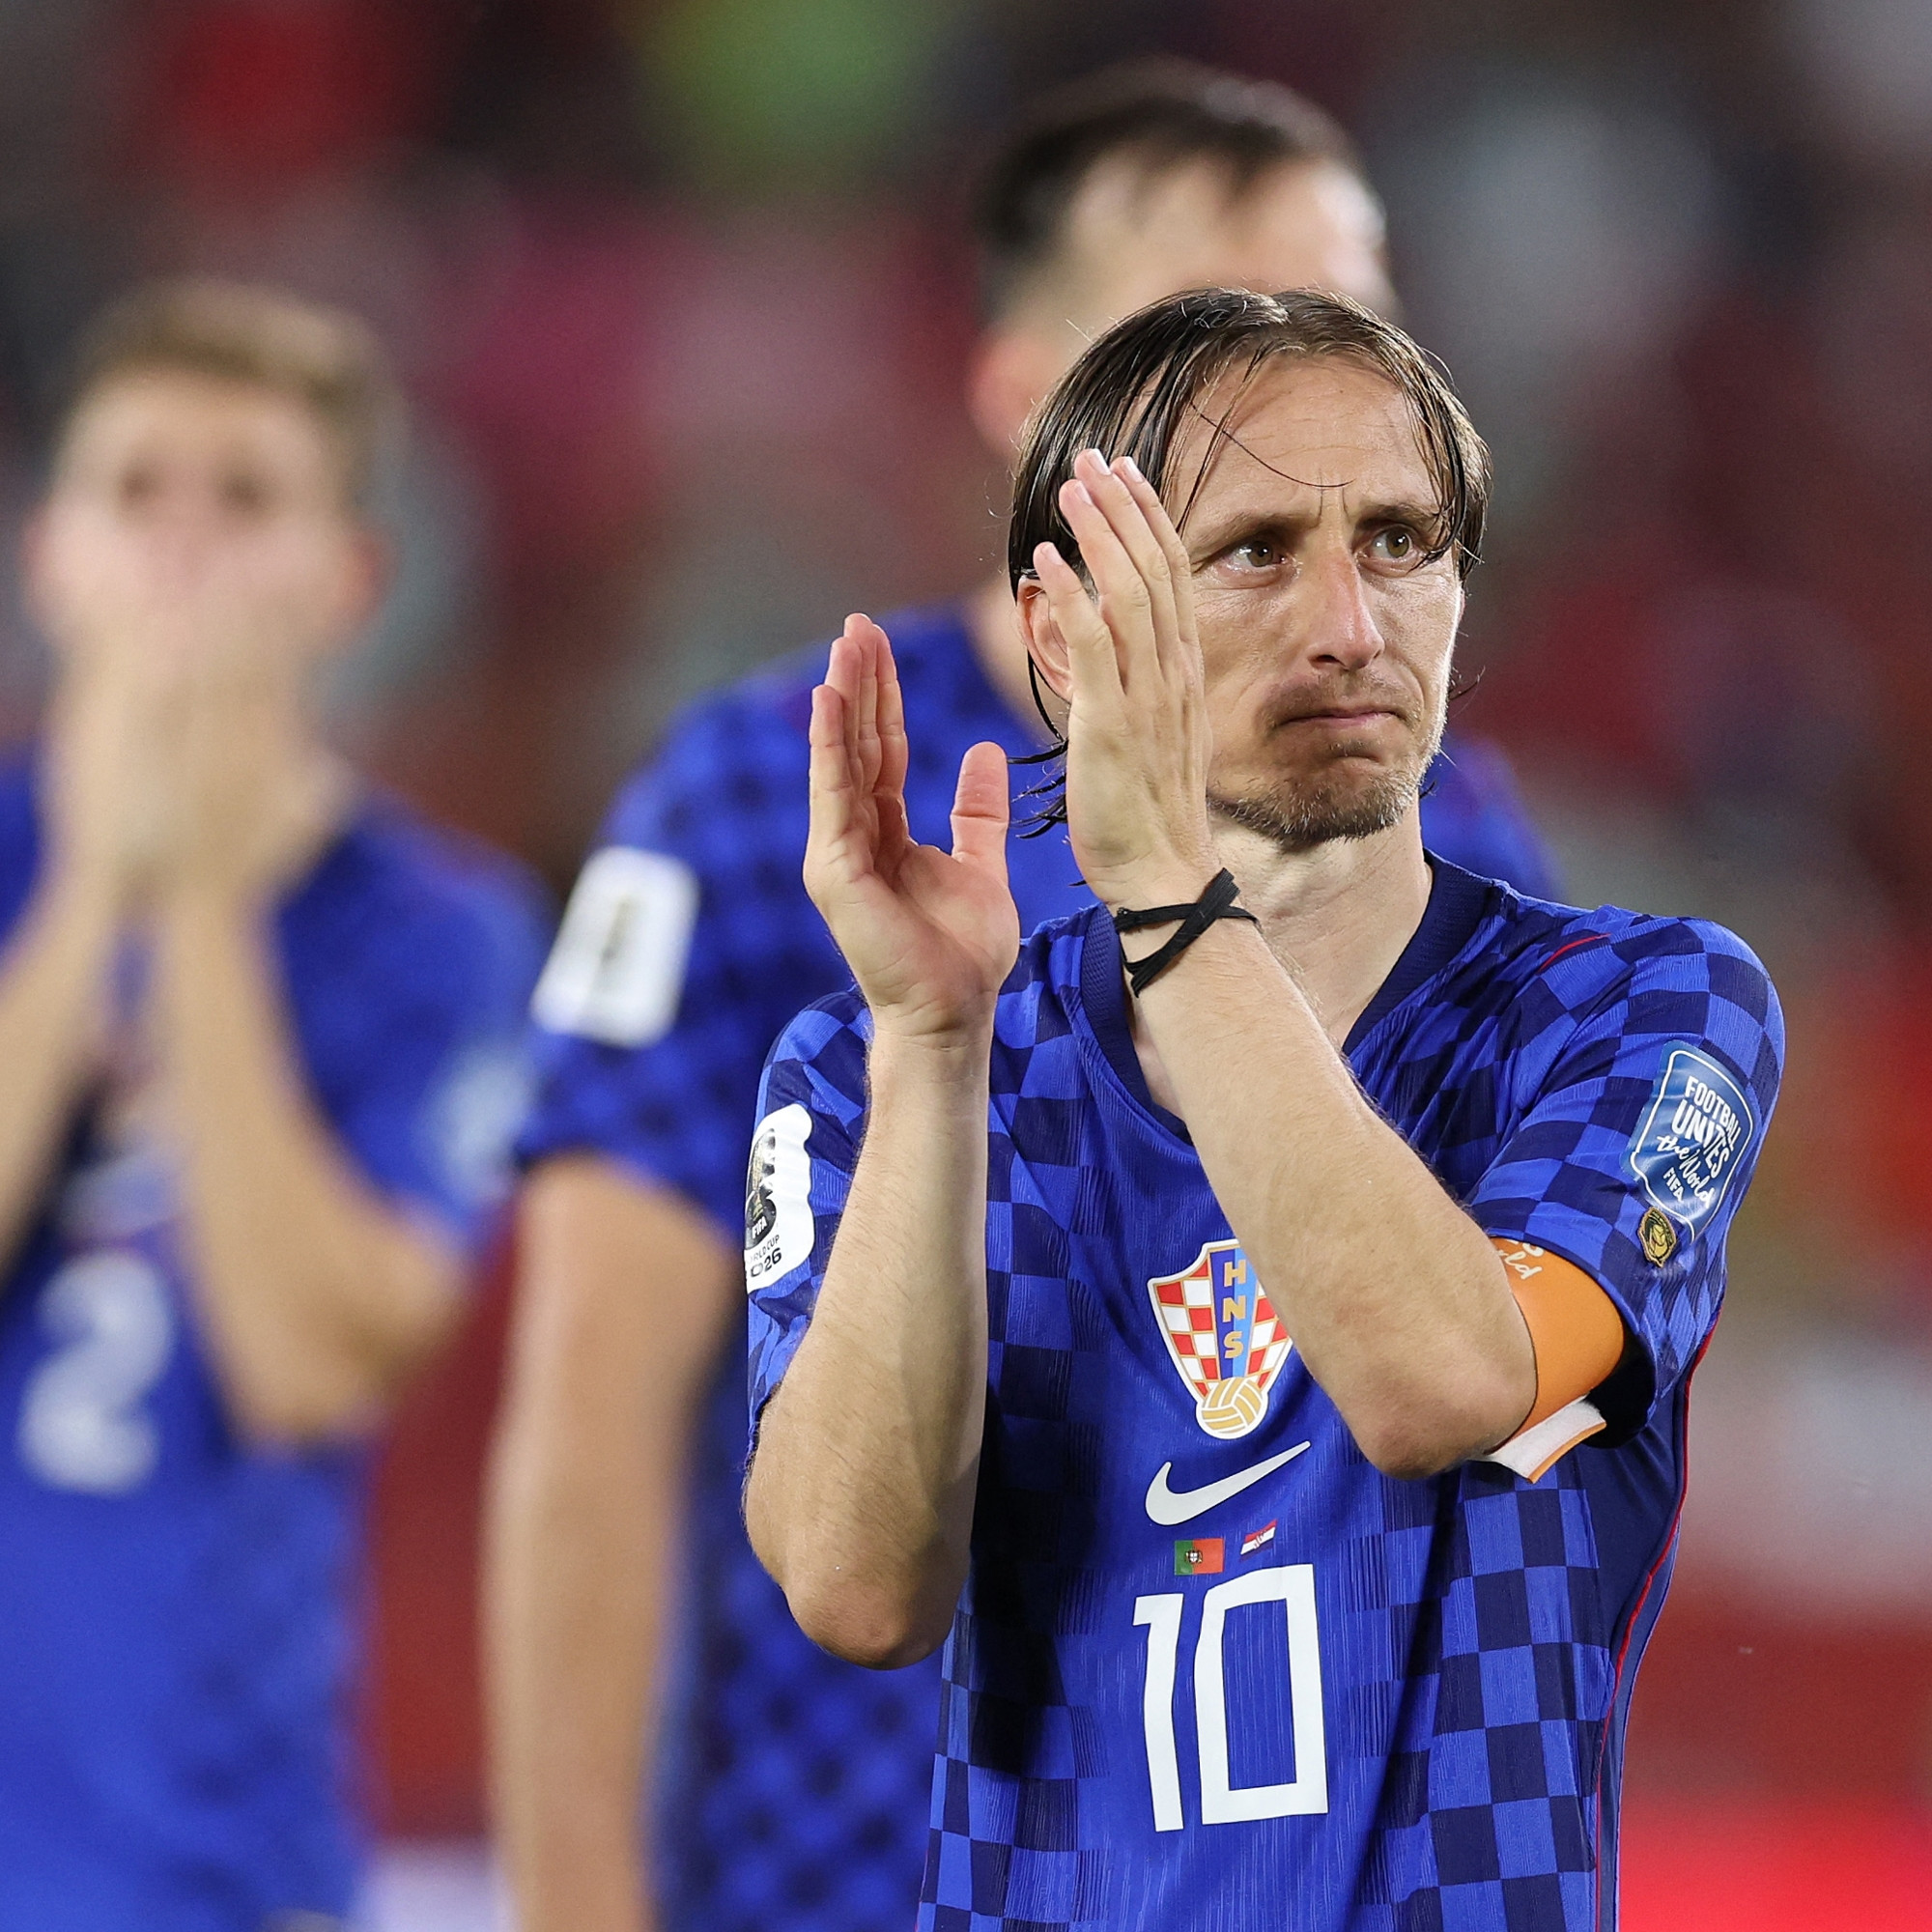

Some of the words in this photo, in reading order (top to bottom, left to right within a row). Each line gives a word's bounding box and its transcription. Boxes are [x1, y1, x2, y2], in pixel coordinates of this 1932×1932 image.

[1671, 1098, 1730, 1179] UNITES
[1685, 1075, 1742, 1151] FOOTBALL
[1656, 1135, 1690, 1160] the
[1679, 1149, 1715, 1209] World
[1662, 1167, 1684, 1203] FIFA
[745, 1247, 781, 1278] 026
[752, 1215, 767, 1239] FIFA
[1222, 1259, 1246, 1359] HNS
[15, 1254, 174, 1497] 2
[1132, 1563, 1329, 1833] 10
